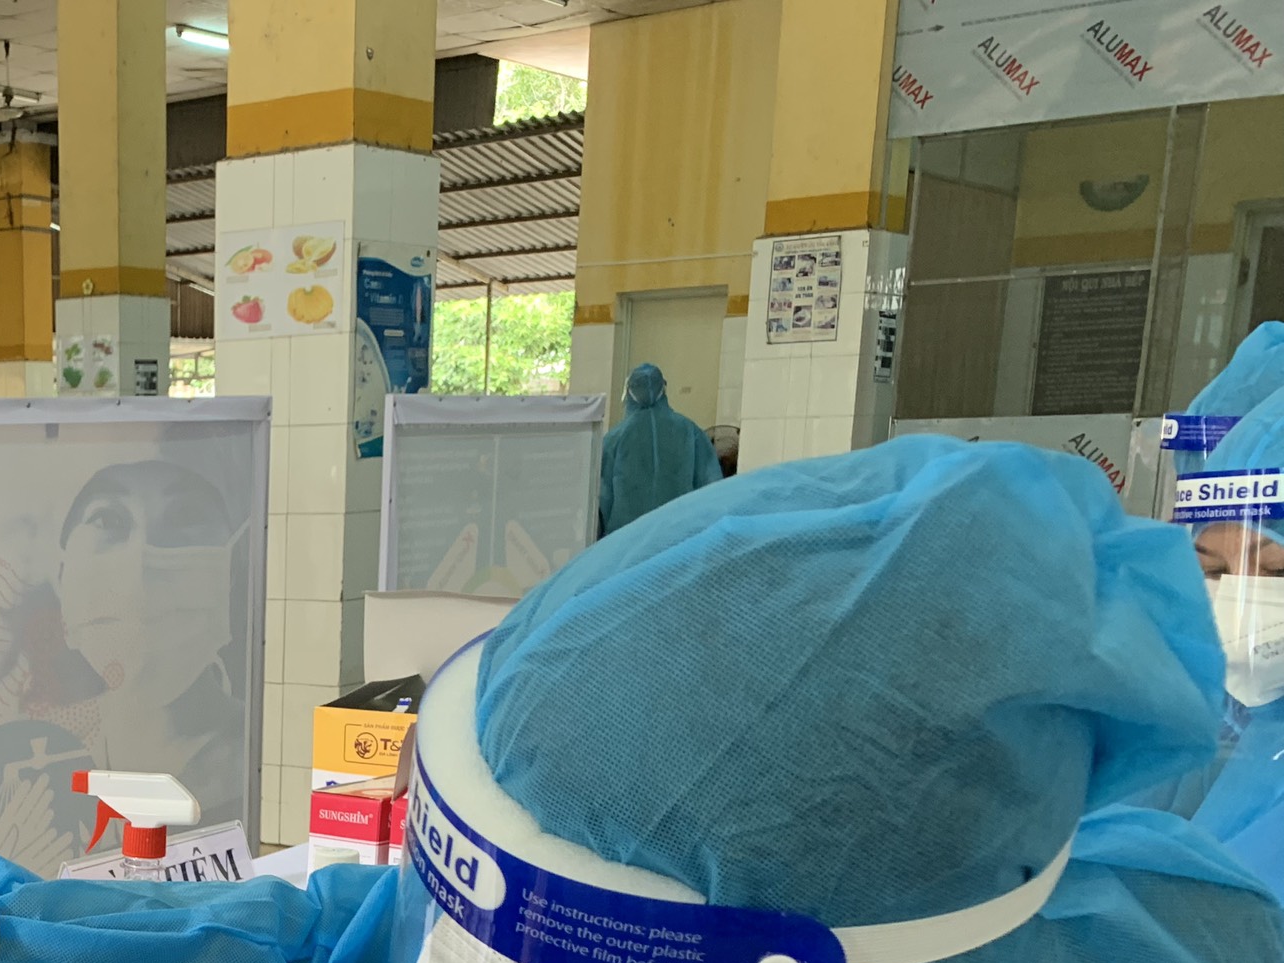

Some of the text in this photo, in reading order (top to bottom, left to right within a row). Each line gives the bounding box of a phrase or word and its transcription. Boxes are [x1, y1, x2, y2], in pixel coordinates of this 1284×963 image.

[1087, 20, 1153, 81] ALUMAX
[1203, 5, 1273, 68] ALUMAX
[892, 65, 933, 109] UMAX
[978, 37, 1040, 95] ALUMAX
[1194, 507, 1236, 518] isolation
[1239, 505, 1272, 516] mask
[1198, 480, 1279, 501] Shield
[380, 738, 403, 752] T&
[412, 781, 480, 891] hield
[427, 869, 465, 919] mask
[522, 888, 703, 944] Use instructions: please
[516, 922, 589, 956] protective
[519, 906, 707, 962] remove the outer plastic
